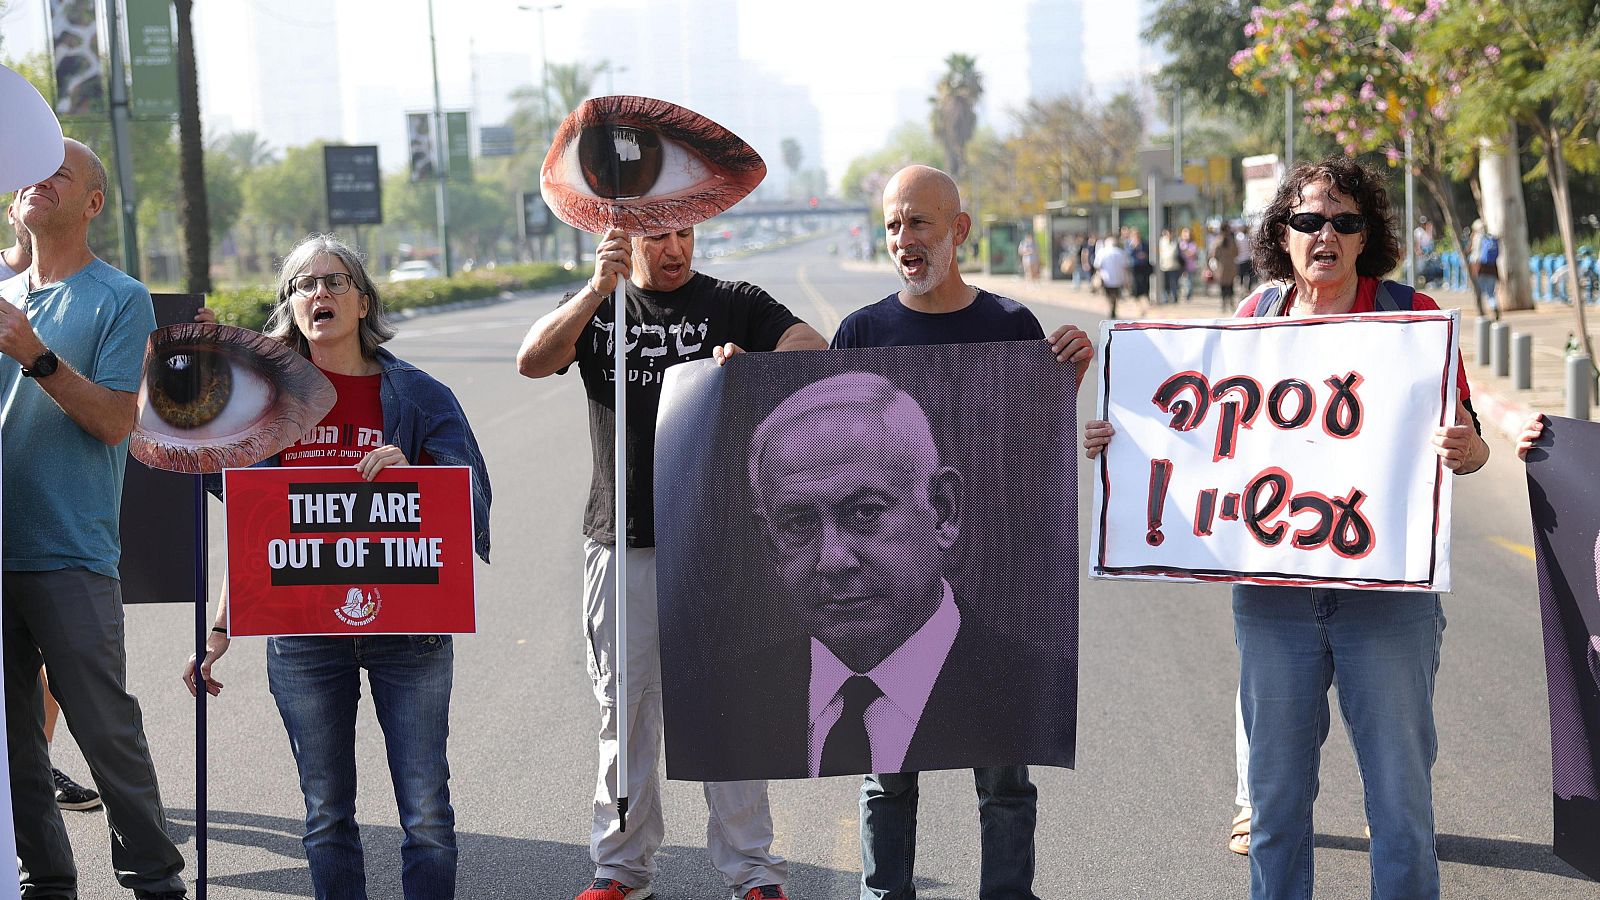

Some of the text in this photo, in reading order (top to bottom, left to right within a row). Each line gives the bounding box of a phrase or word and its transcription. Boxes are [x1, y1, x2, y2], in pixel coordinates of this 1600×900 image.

[1152, 369, 1366, 462] עסקה
[326, 449, 337, 457] לא
[357, 427, 385, 447] בק
[288, 492, 422, 525] THEY ARE
[267, 537, 444, 569] OUT OF TIME
